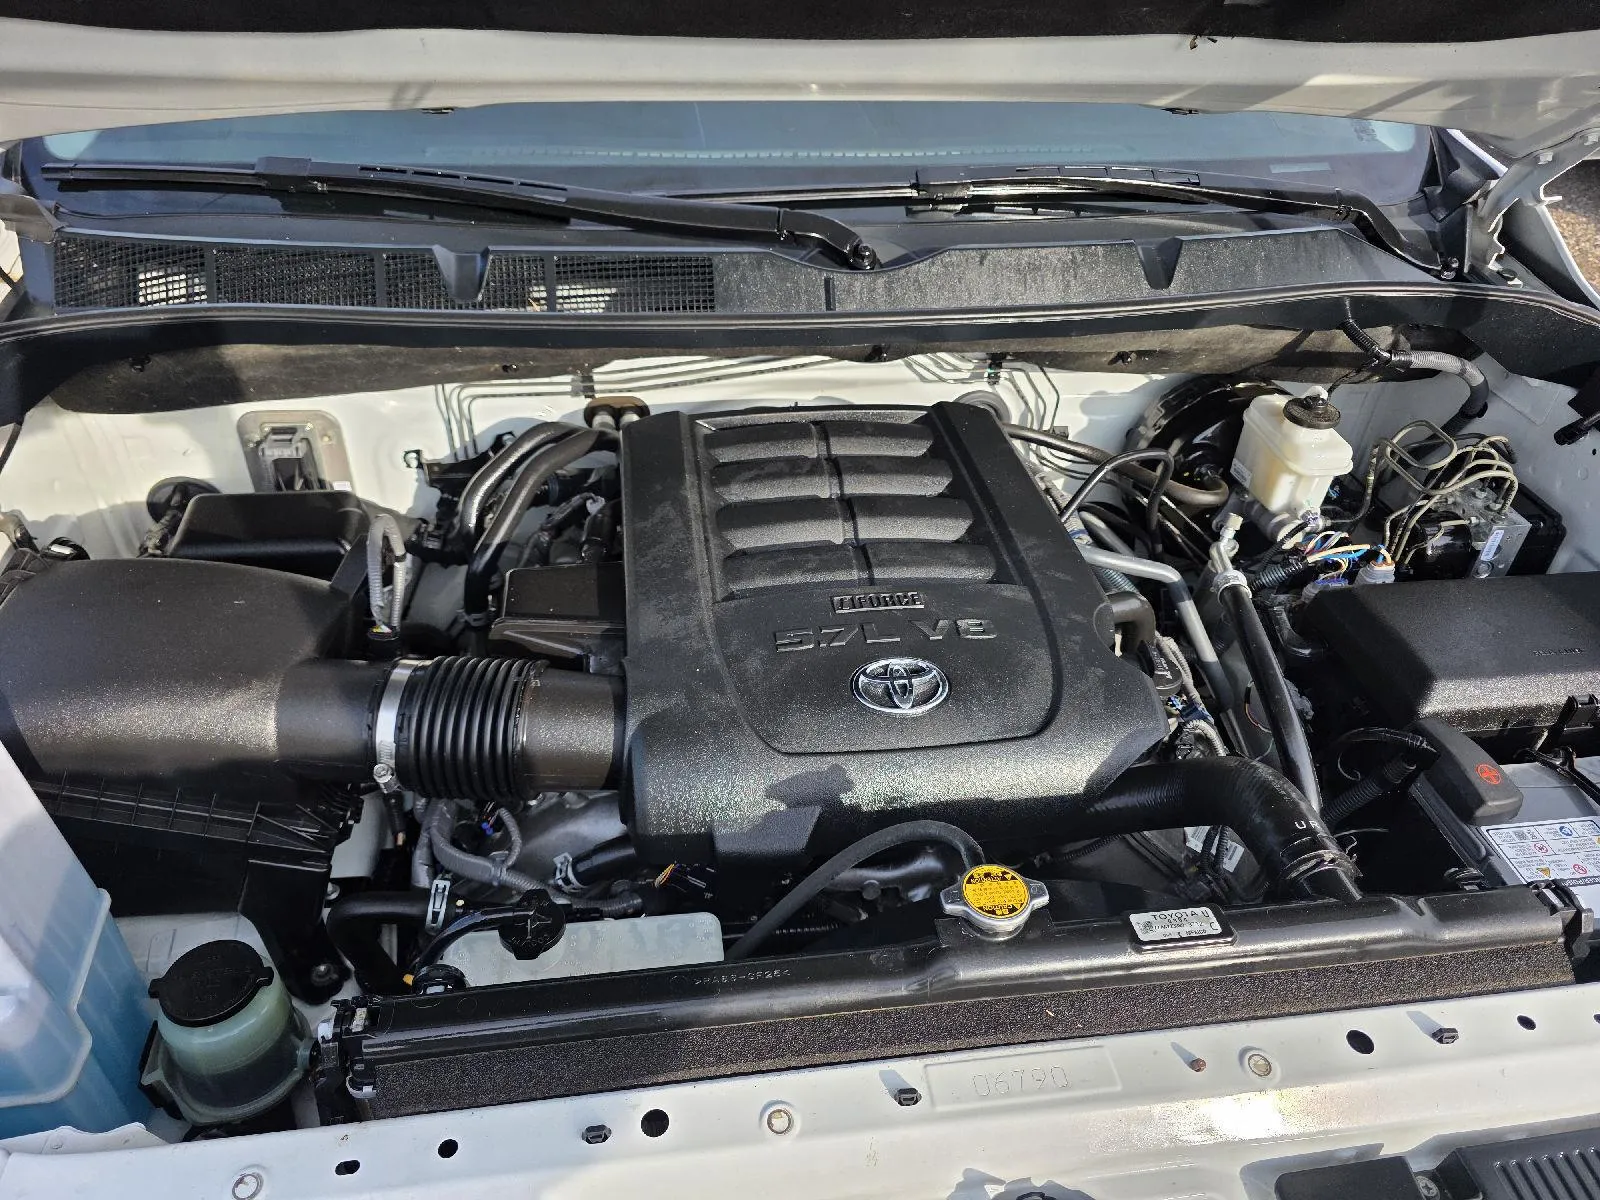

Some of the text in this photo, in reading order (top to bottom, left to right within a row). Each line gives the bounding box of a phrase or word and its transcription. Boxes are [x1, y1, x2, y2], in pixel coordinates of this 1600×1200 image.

[908, 617, 998, 641] V8
[1151, 910, 1199, 921] TOYOTA
[972, 1065, 1069, 1097] 06790
